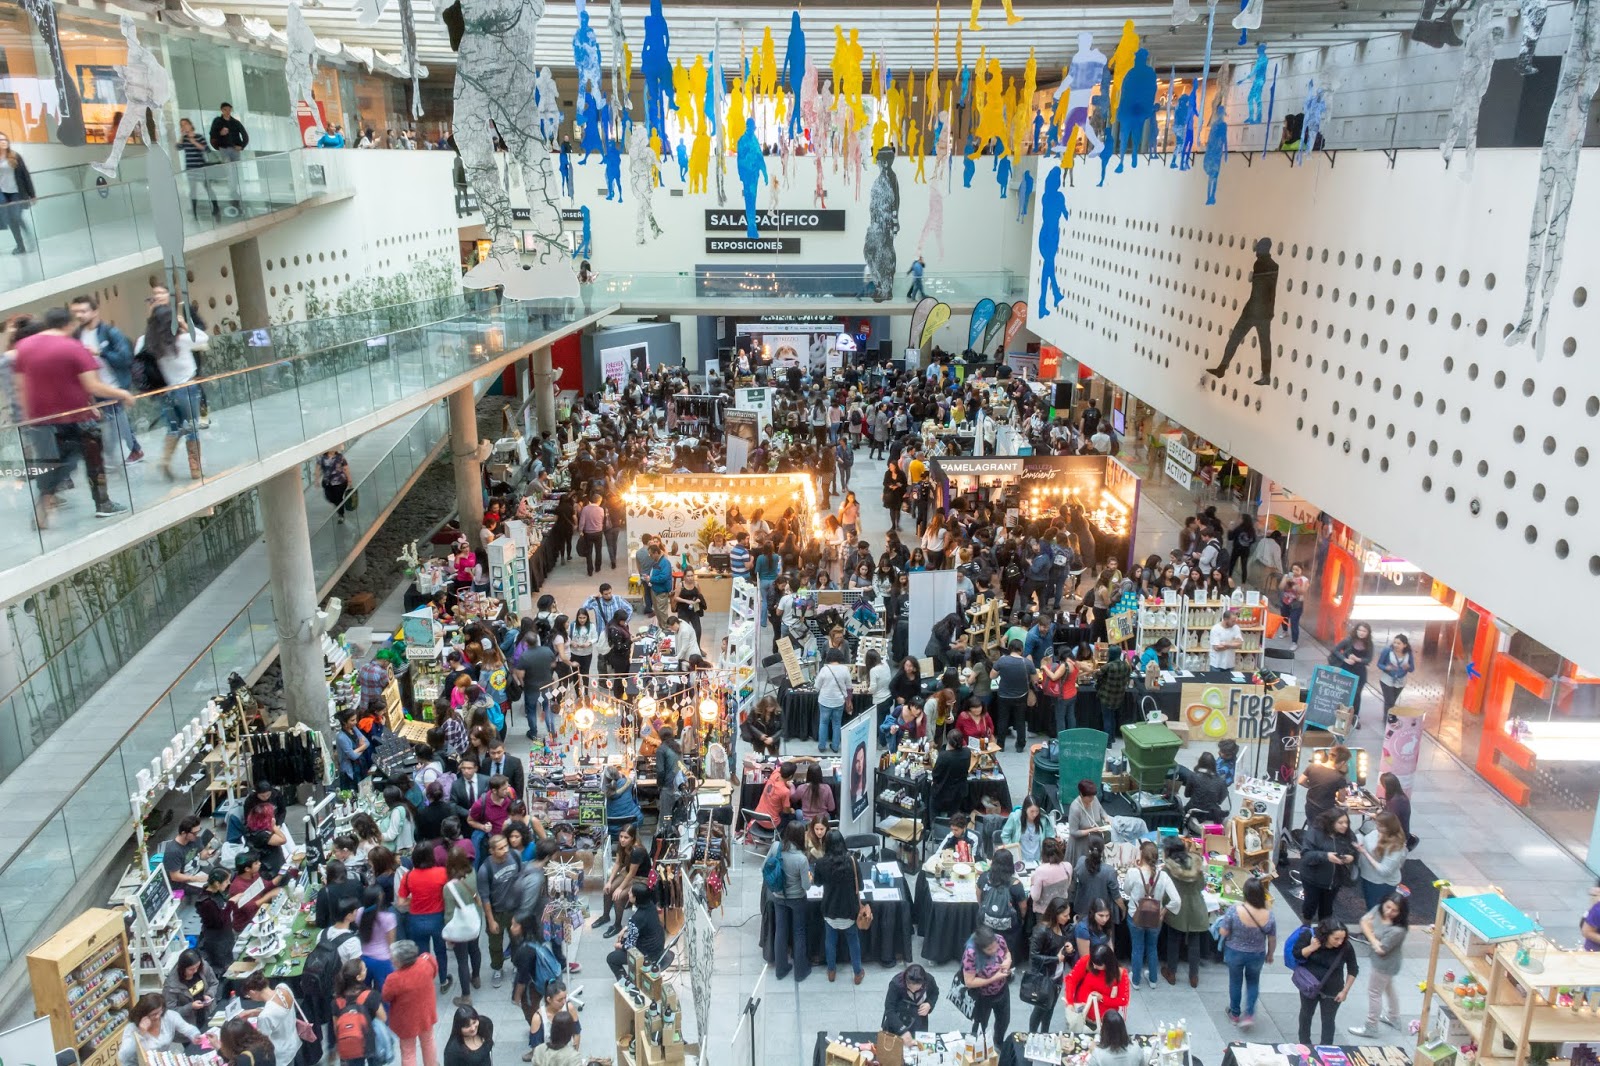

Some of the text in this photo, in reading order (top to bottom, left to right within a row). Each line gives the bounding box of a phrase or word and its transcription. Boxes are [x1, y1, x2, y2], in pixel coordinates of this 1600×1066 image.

[710, 212, 819, 226] SALA PACÍFICO
[711, 241, 783, 250] EXPOSICIONES
[1169, 441, 1192, 465] ESPACIO
[940, 463, 1018, 472] PAMELAGRANT
[1166, 461, 1188, 484] ACTIVO
[1228, 688, 1274, 718] Free
